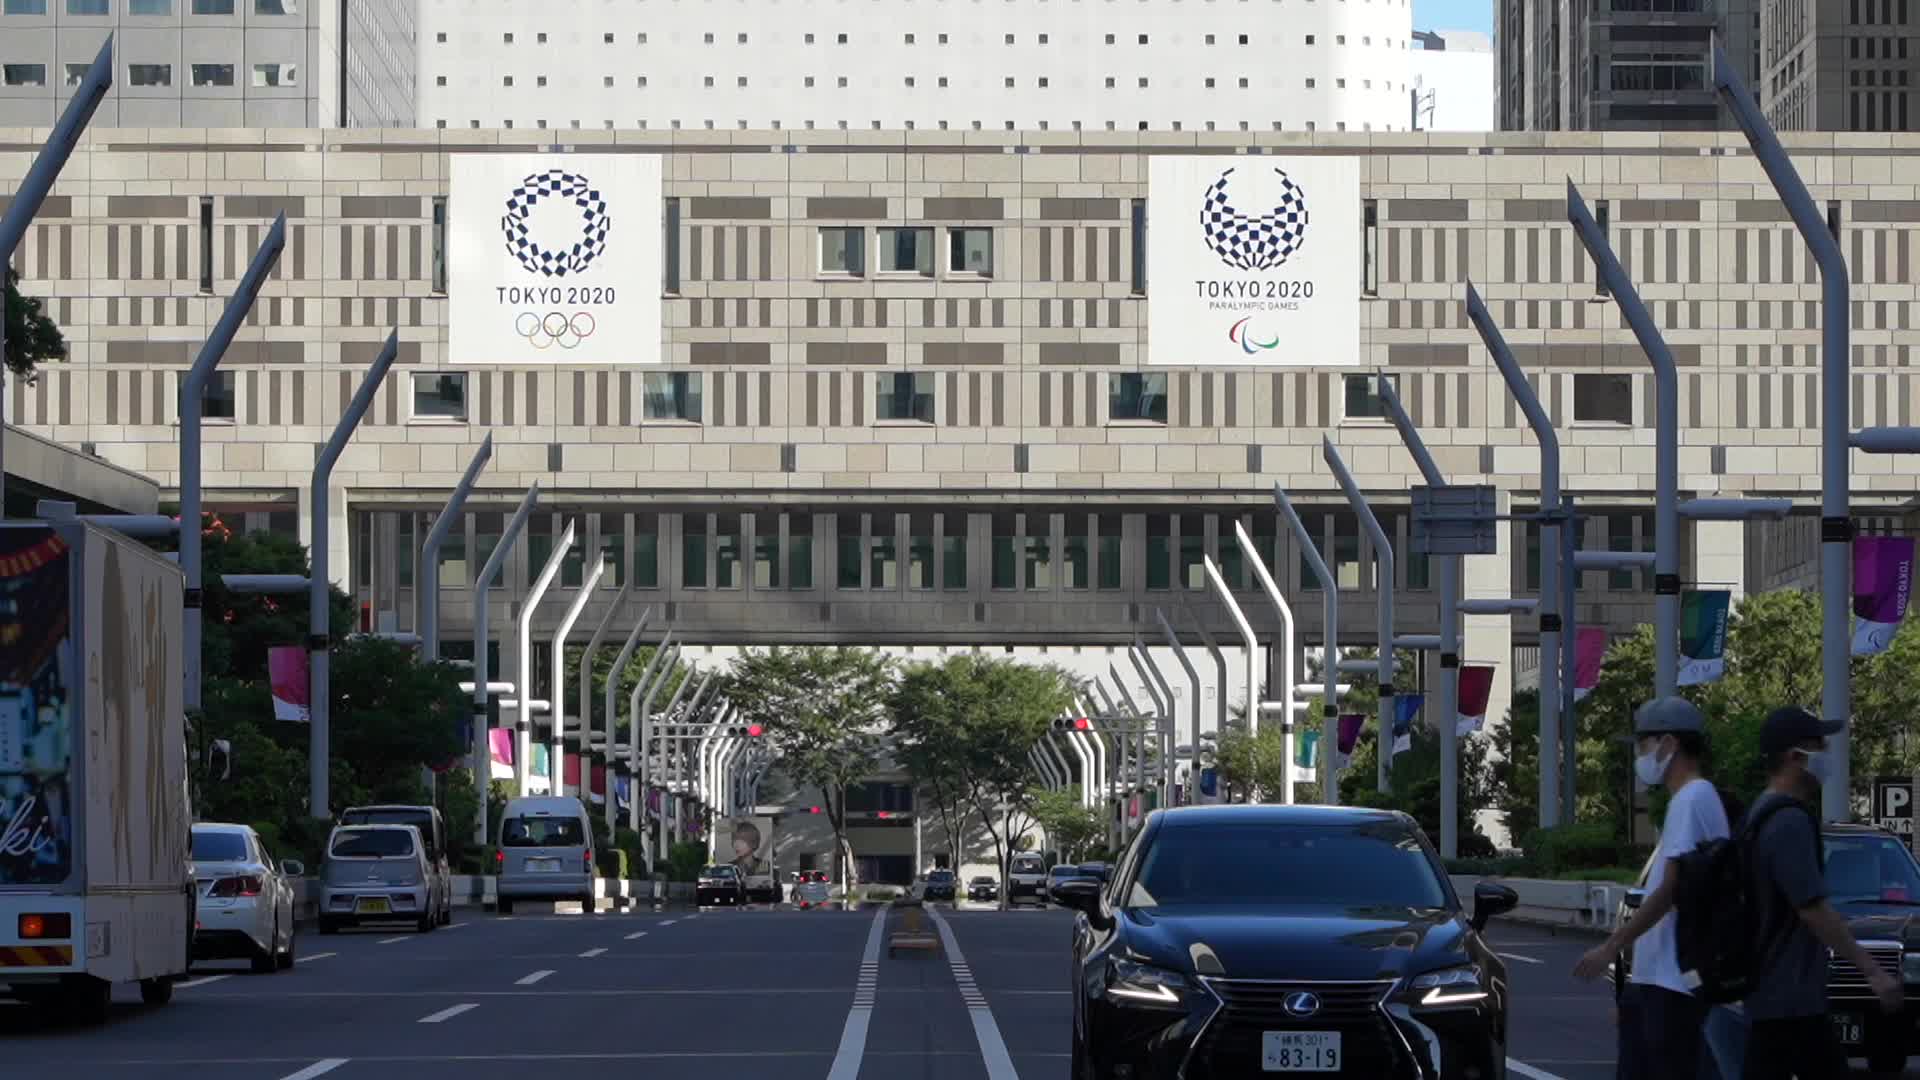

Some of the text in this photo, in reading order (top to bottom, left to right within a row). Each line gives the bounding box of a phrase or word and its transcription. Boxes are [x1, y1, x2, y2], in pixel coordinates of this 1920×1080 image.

[496, 287, 615, 304] TOKYO 2020
[1195, 281, 1313, 298] TOKYO 2020
[1209, 302, 1299, 311] PARALYMPIC GAMES
[1898, 560, 1910, 592] TOKYO
[1886, 787, 1909, 816] P
[1280, 1048, 1336, 1068] 83-19
